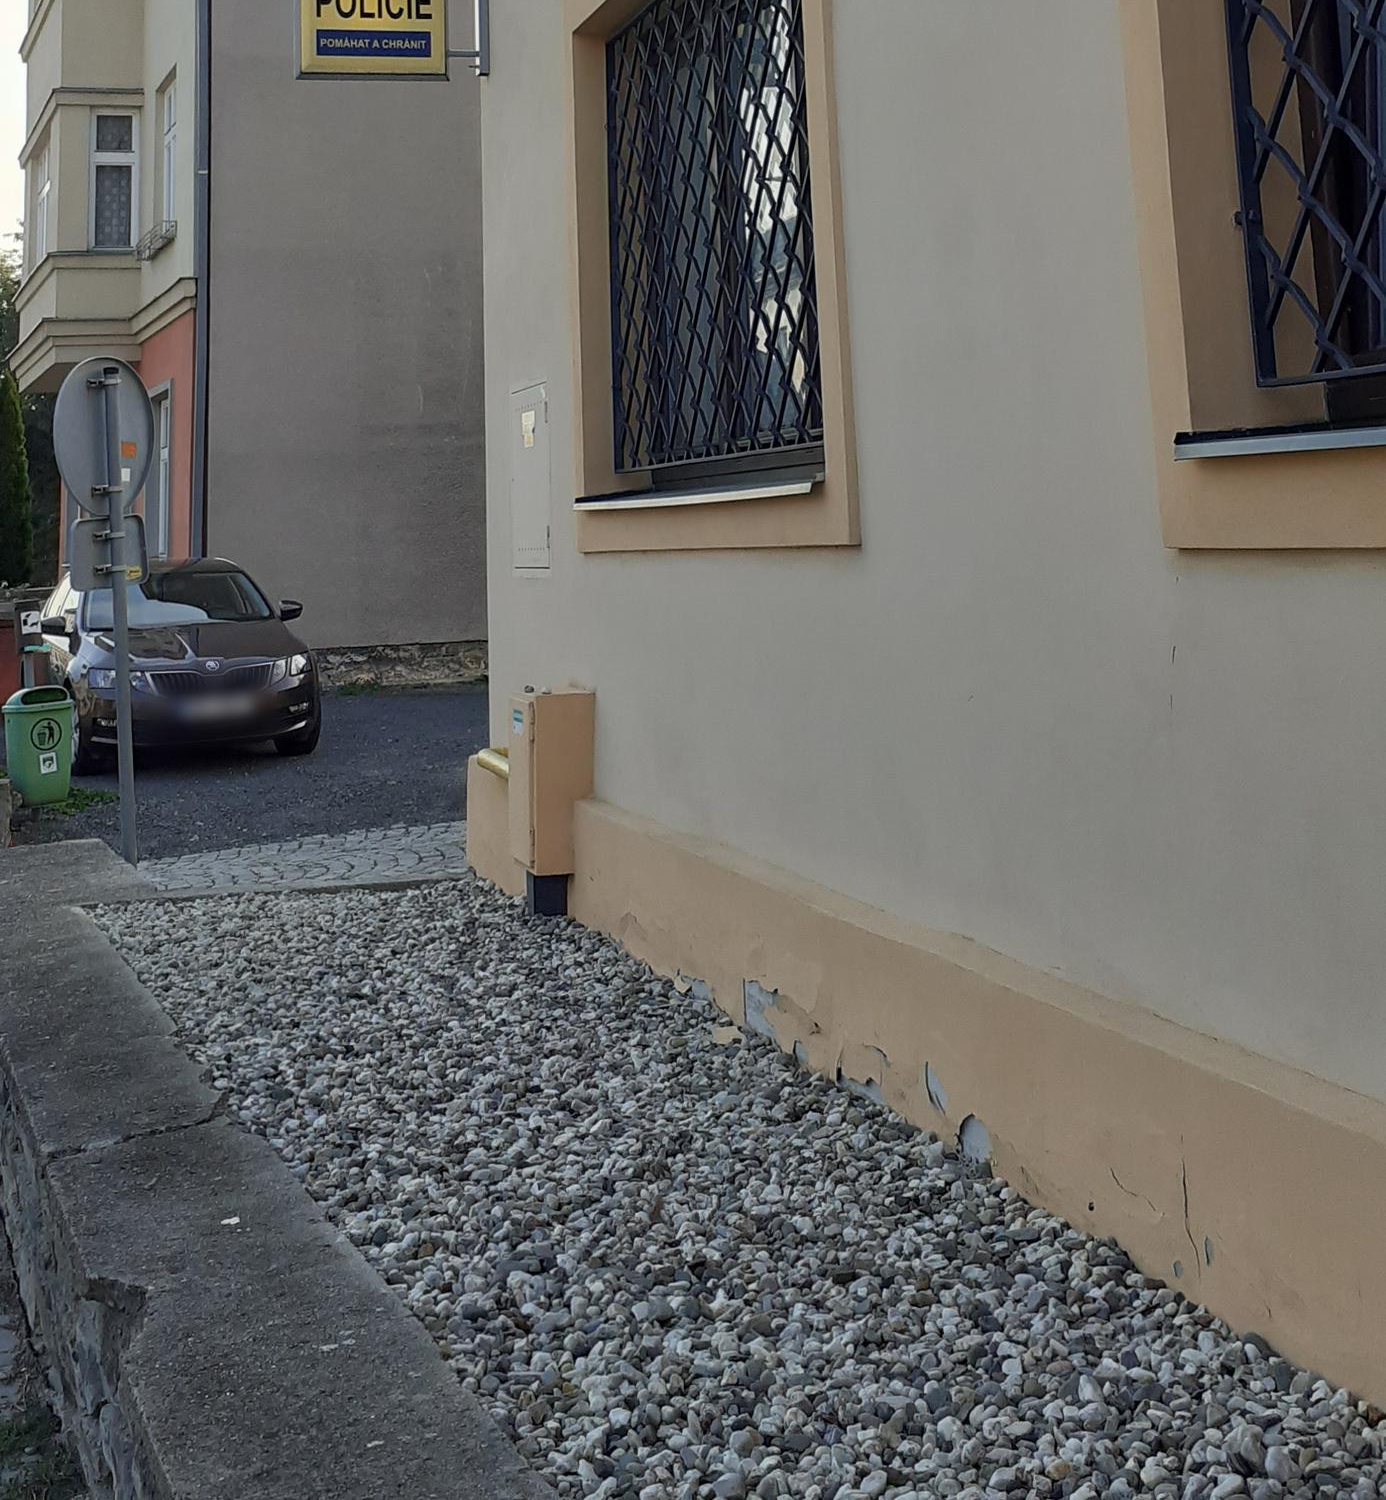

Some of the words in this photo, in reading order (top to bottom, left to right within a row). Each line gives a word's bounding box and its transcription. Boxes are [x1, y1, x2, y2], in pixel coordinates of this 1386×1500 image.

[320, 37, 370, 48] POMÁHAT
[372, 39, 380, 49] A
[382, 38, 426, 50] CHRÁNIT
